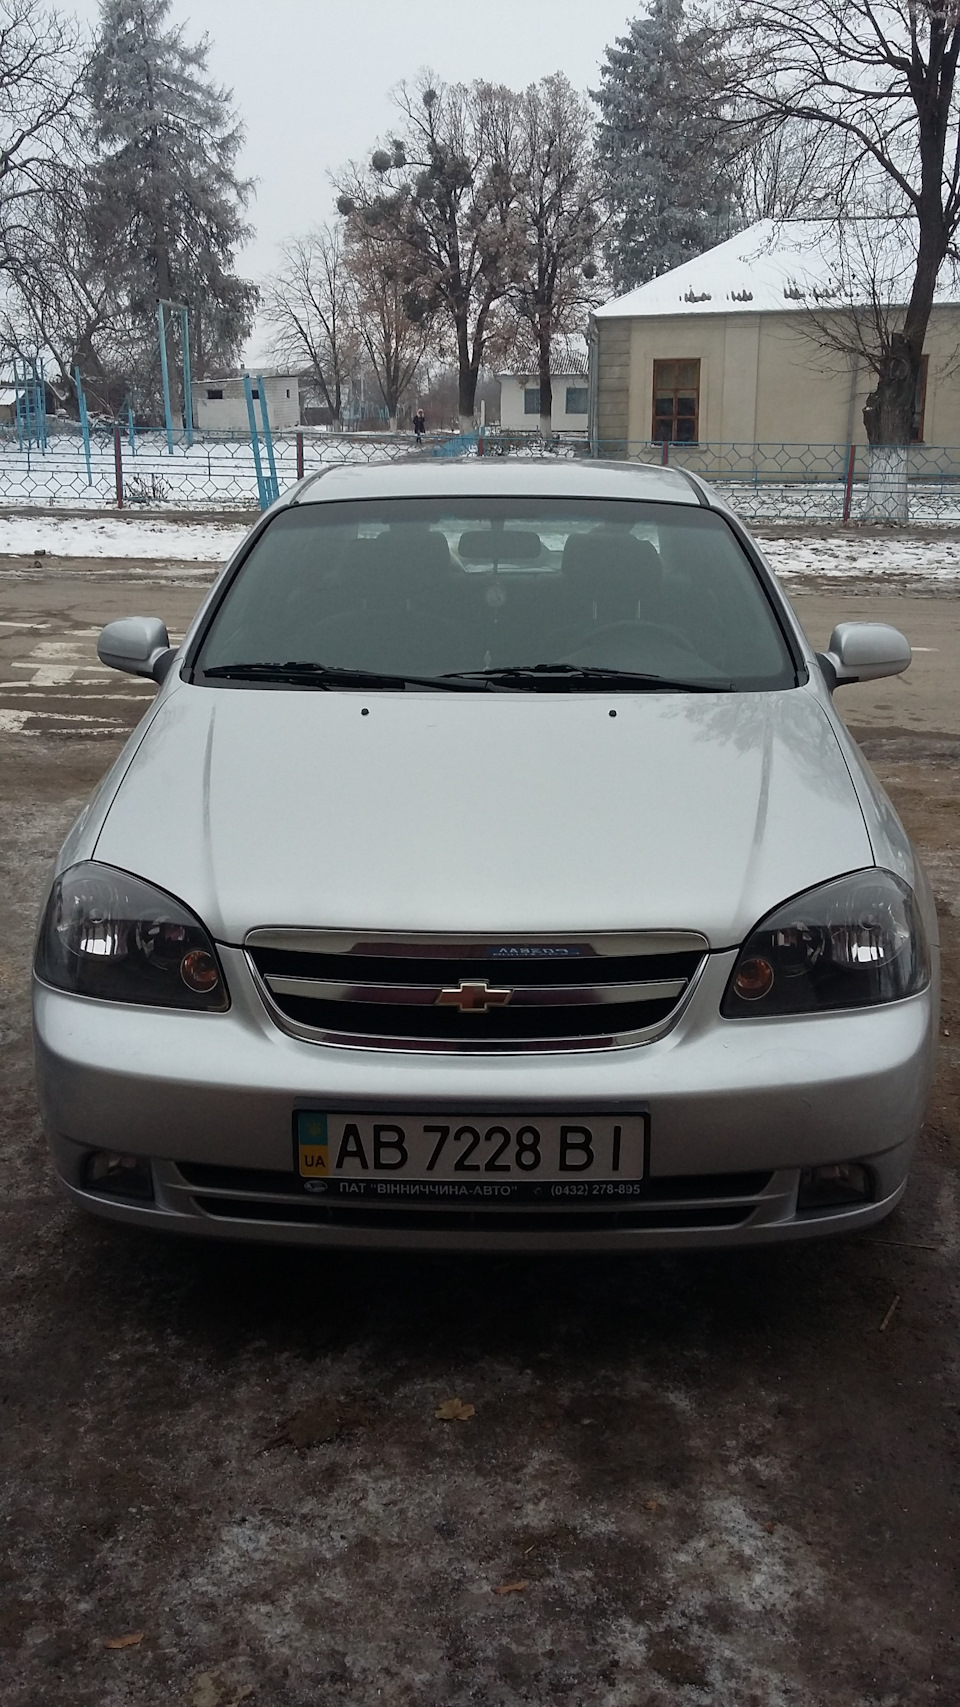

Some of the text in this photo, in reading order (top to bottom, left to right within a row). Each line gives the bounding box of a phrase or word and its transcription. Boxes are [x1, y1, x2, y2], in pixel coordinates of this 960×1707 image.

[335, 1123, 408, 1170] AB
[422, 1125, 542, 1171] 7228
[304, 1155, 326, 1168] UA
[340, 1182, 366, 1193] ПАТ
[551, 1183, 588, 1196] (0432)
